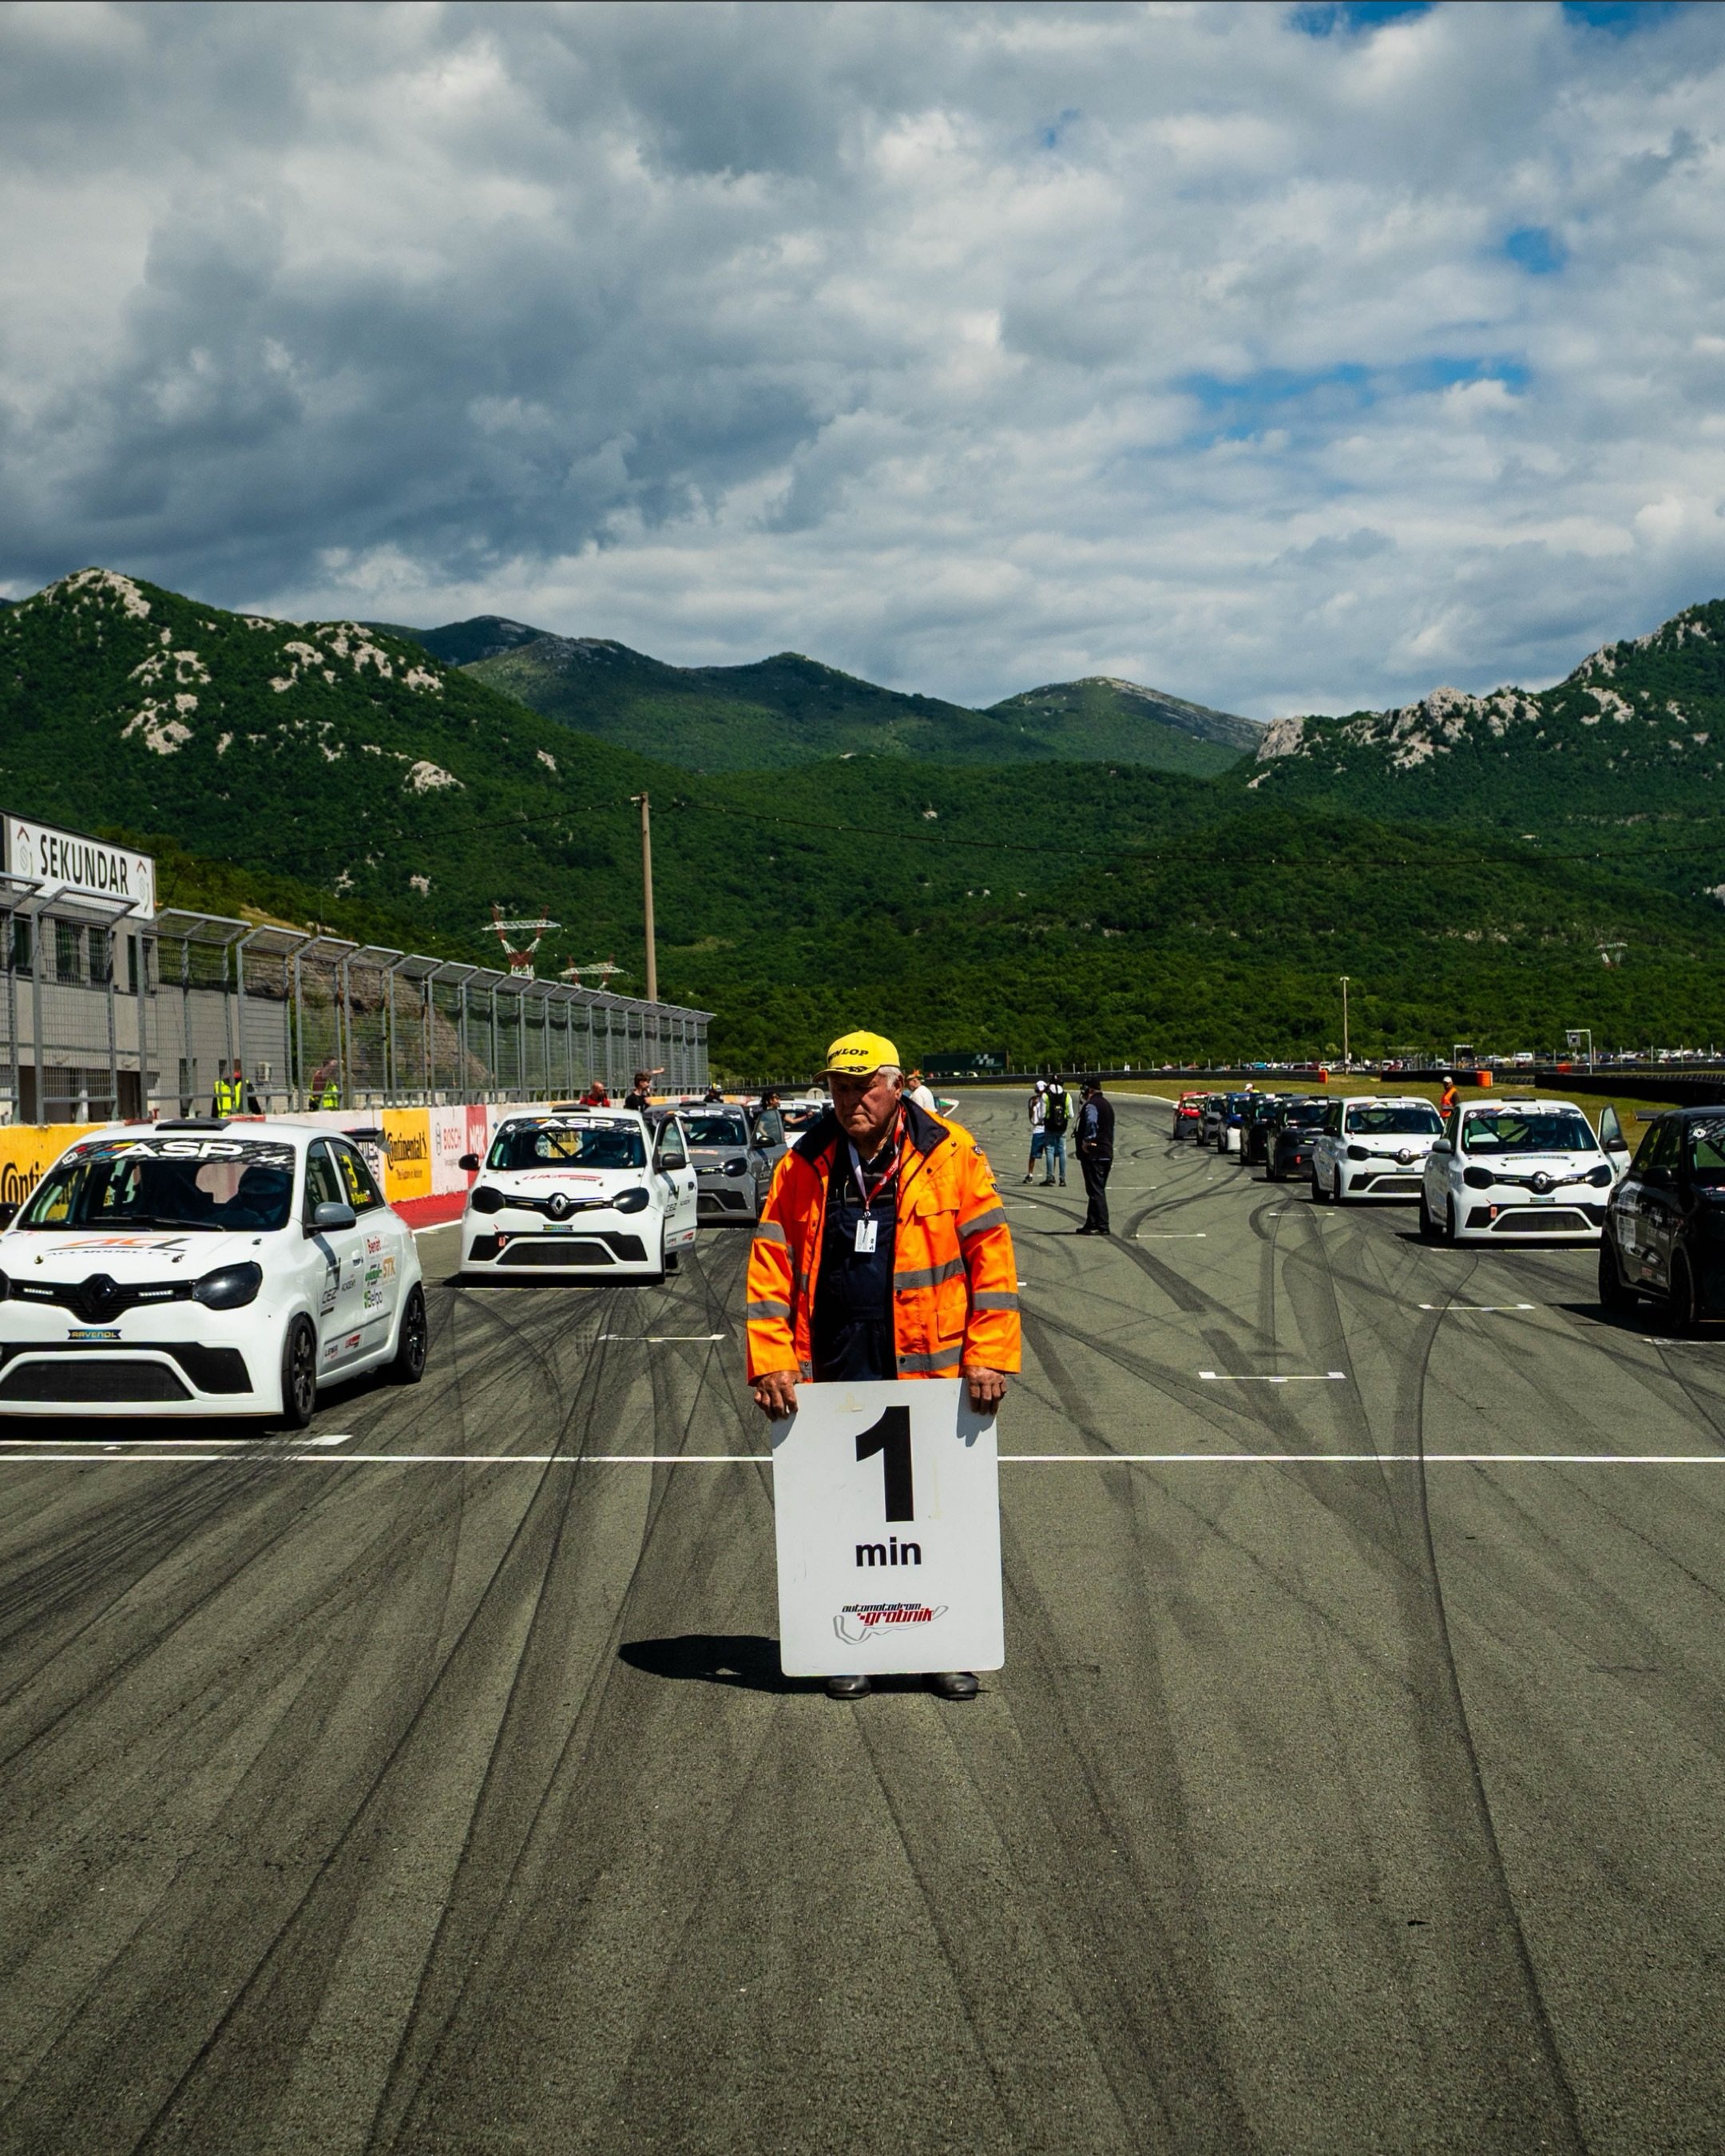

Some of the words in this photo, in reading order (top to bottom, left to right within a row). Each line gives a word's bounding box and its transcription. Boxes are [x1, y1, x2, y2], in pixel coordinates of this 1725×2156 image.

[40, 834, 129, 895] SEKUNDAR
[674, 1109, 724, 1118] ASP
[1497, 1106, 1560, 1115] ASP
[537, 1118, 615, 1128] ASP
[111, 1141, 244, 1159] ASP
[387, 1130, 423, 1171] Continental
[341, 1155, 358, 1188] 3
[383, 1256, 397, 1278] STK
[855, 1405, 914, 1523] 1
[855, 1536, 922, 1567] min
[842, 1602, 922, 1613] automotodrom
[863, 1608, 934, 1627] grobnik
